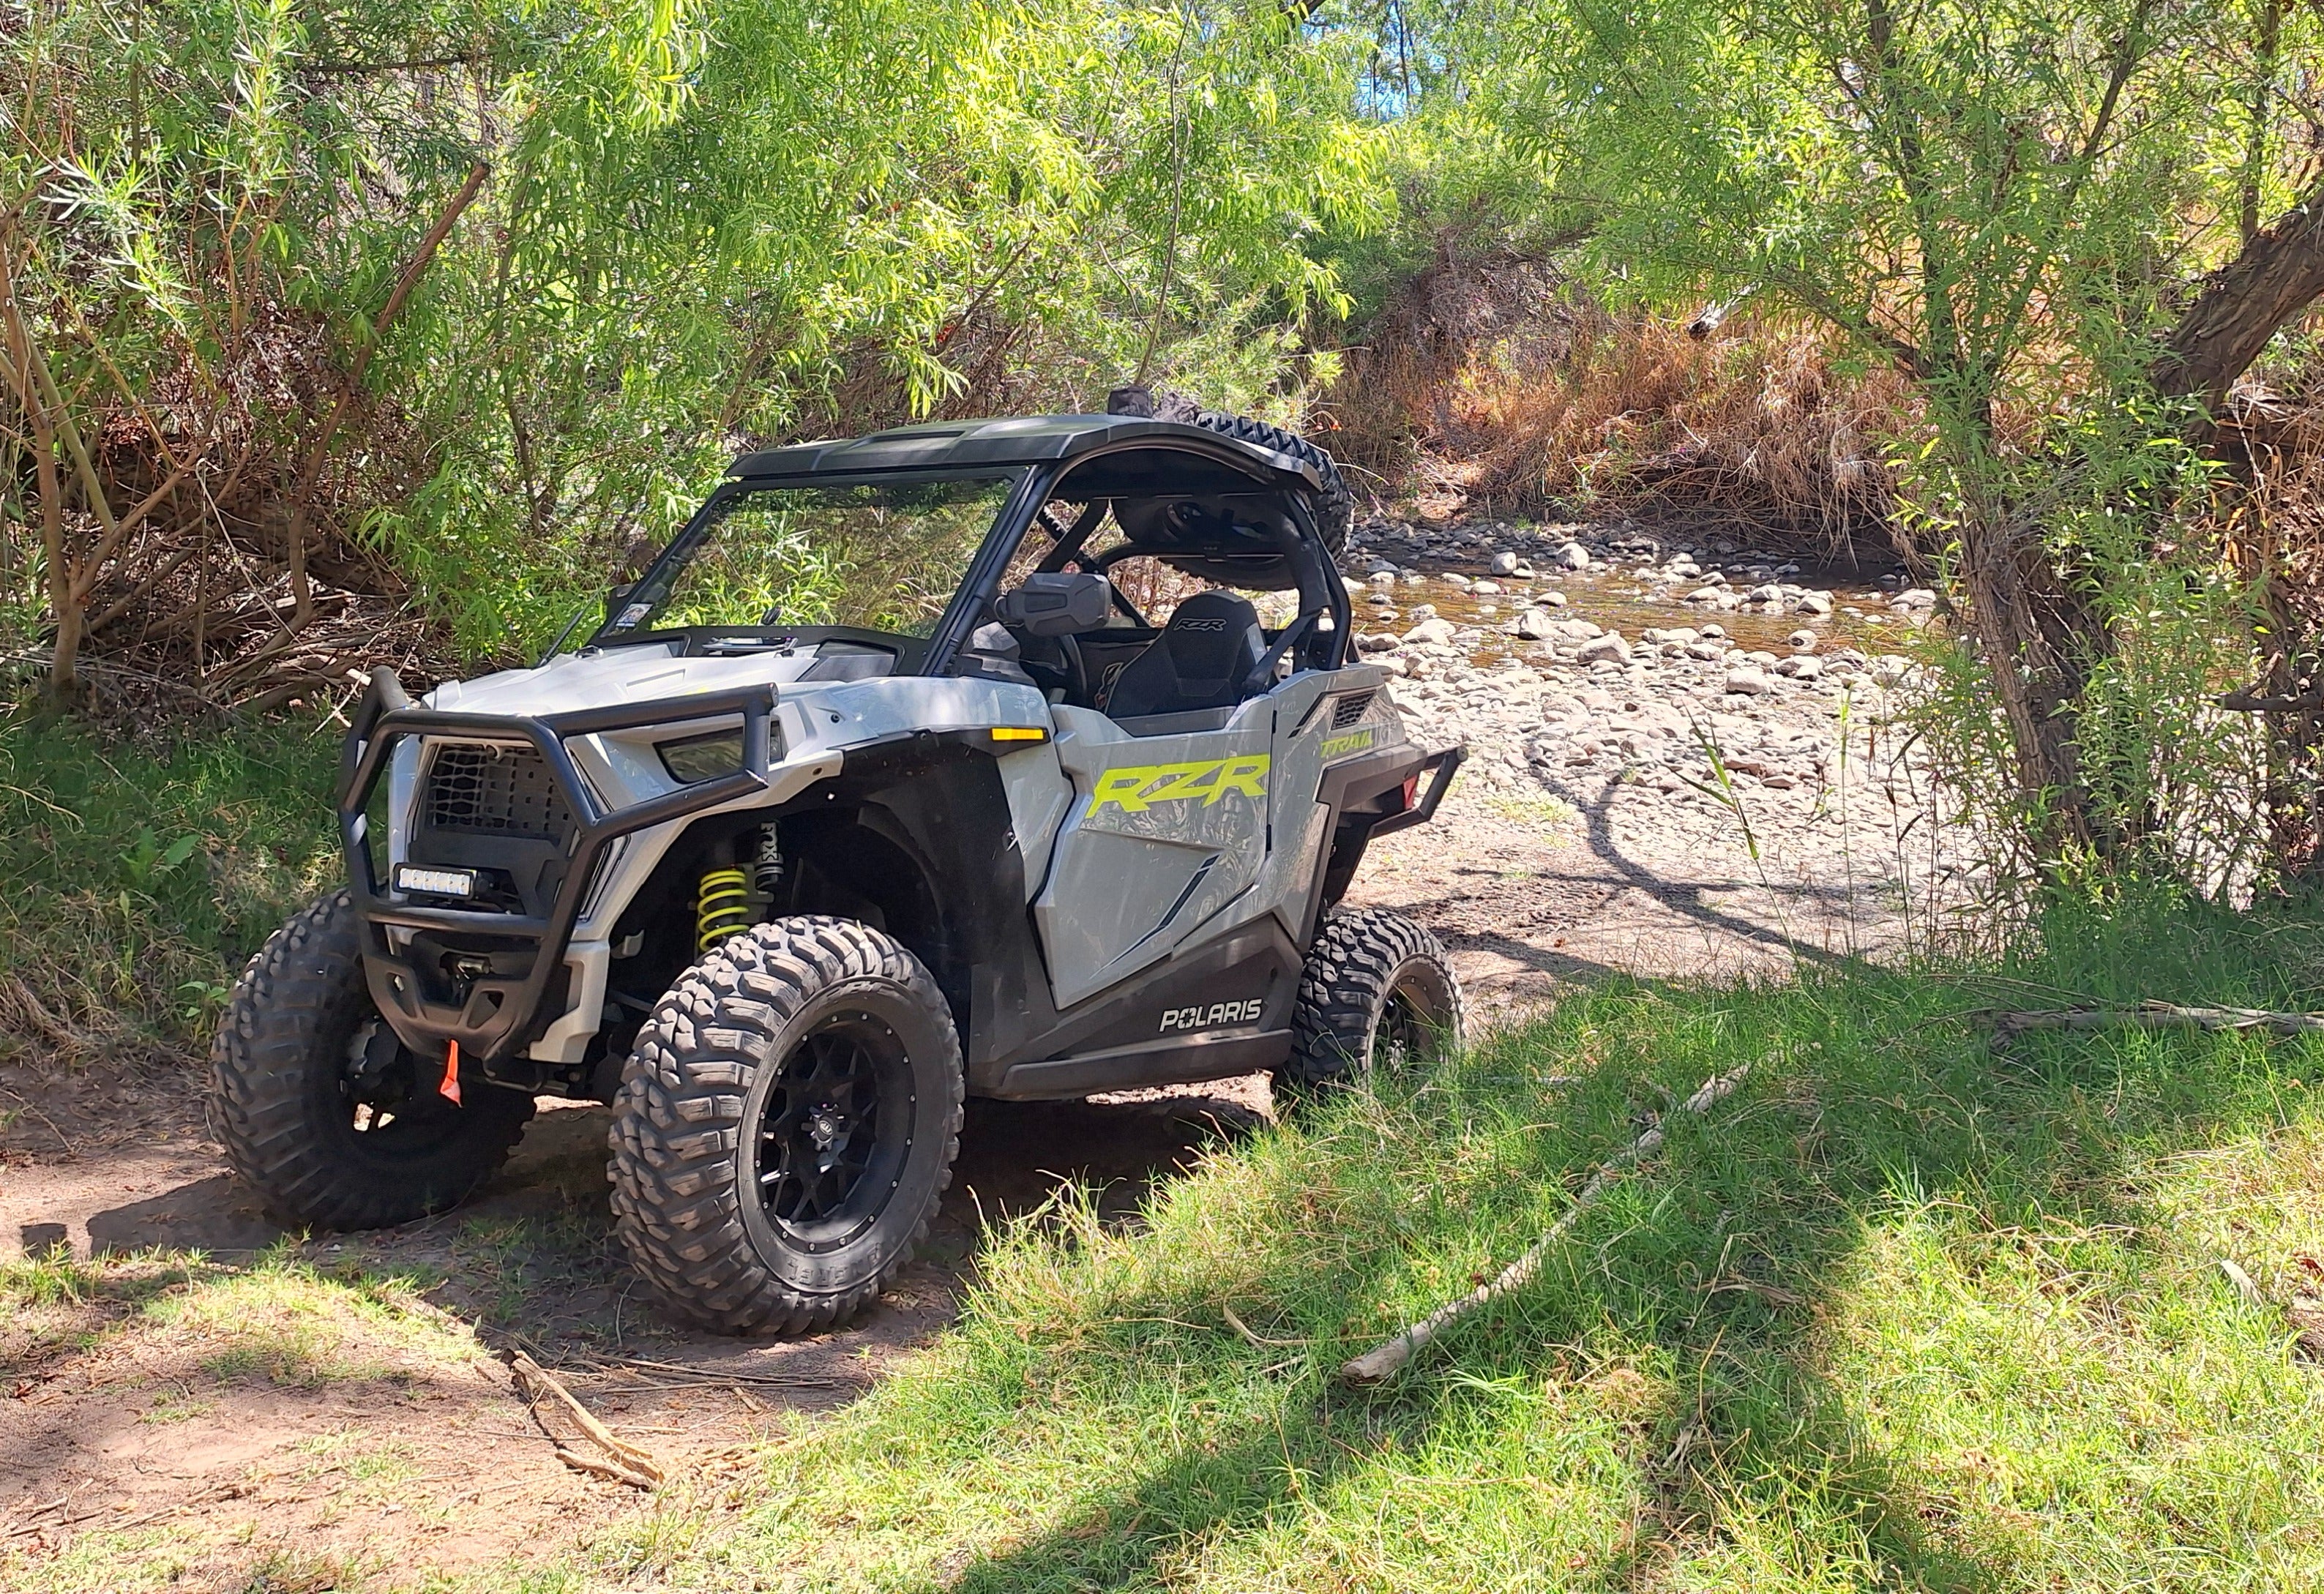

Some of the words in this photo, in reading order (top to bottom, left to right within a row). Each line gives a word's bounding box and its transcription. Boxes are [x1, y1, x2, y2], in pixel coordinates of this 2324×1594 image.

[1173, 618, 1227, 631] RZR
[1320, 730, 1373, 758] TRAIL
[1085, 754, 1271, 819] RZR
[761, 822, 779, 861] FOX
[1159, 998, 1263, 1032] POLARIS
